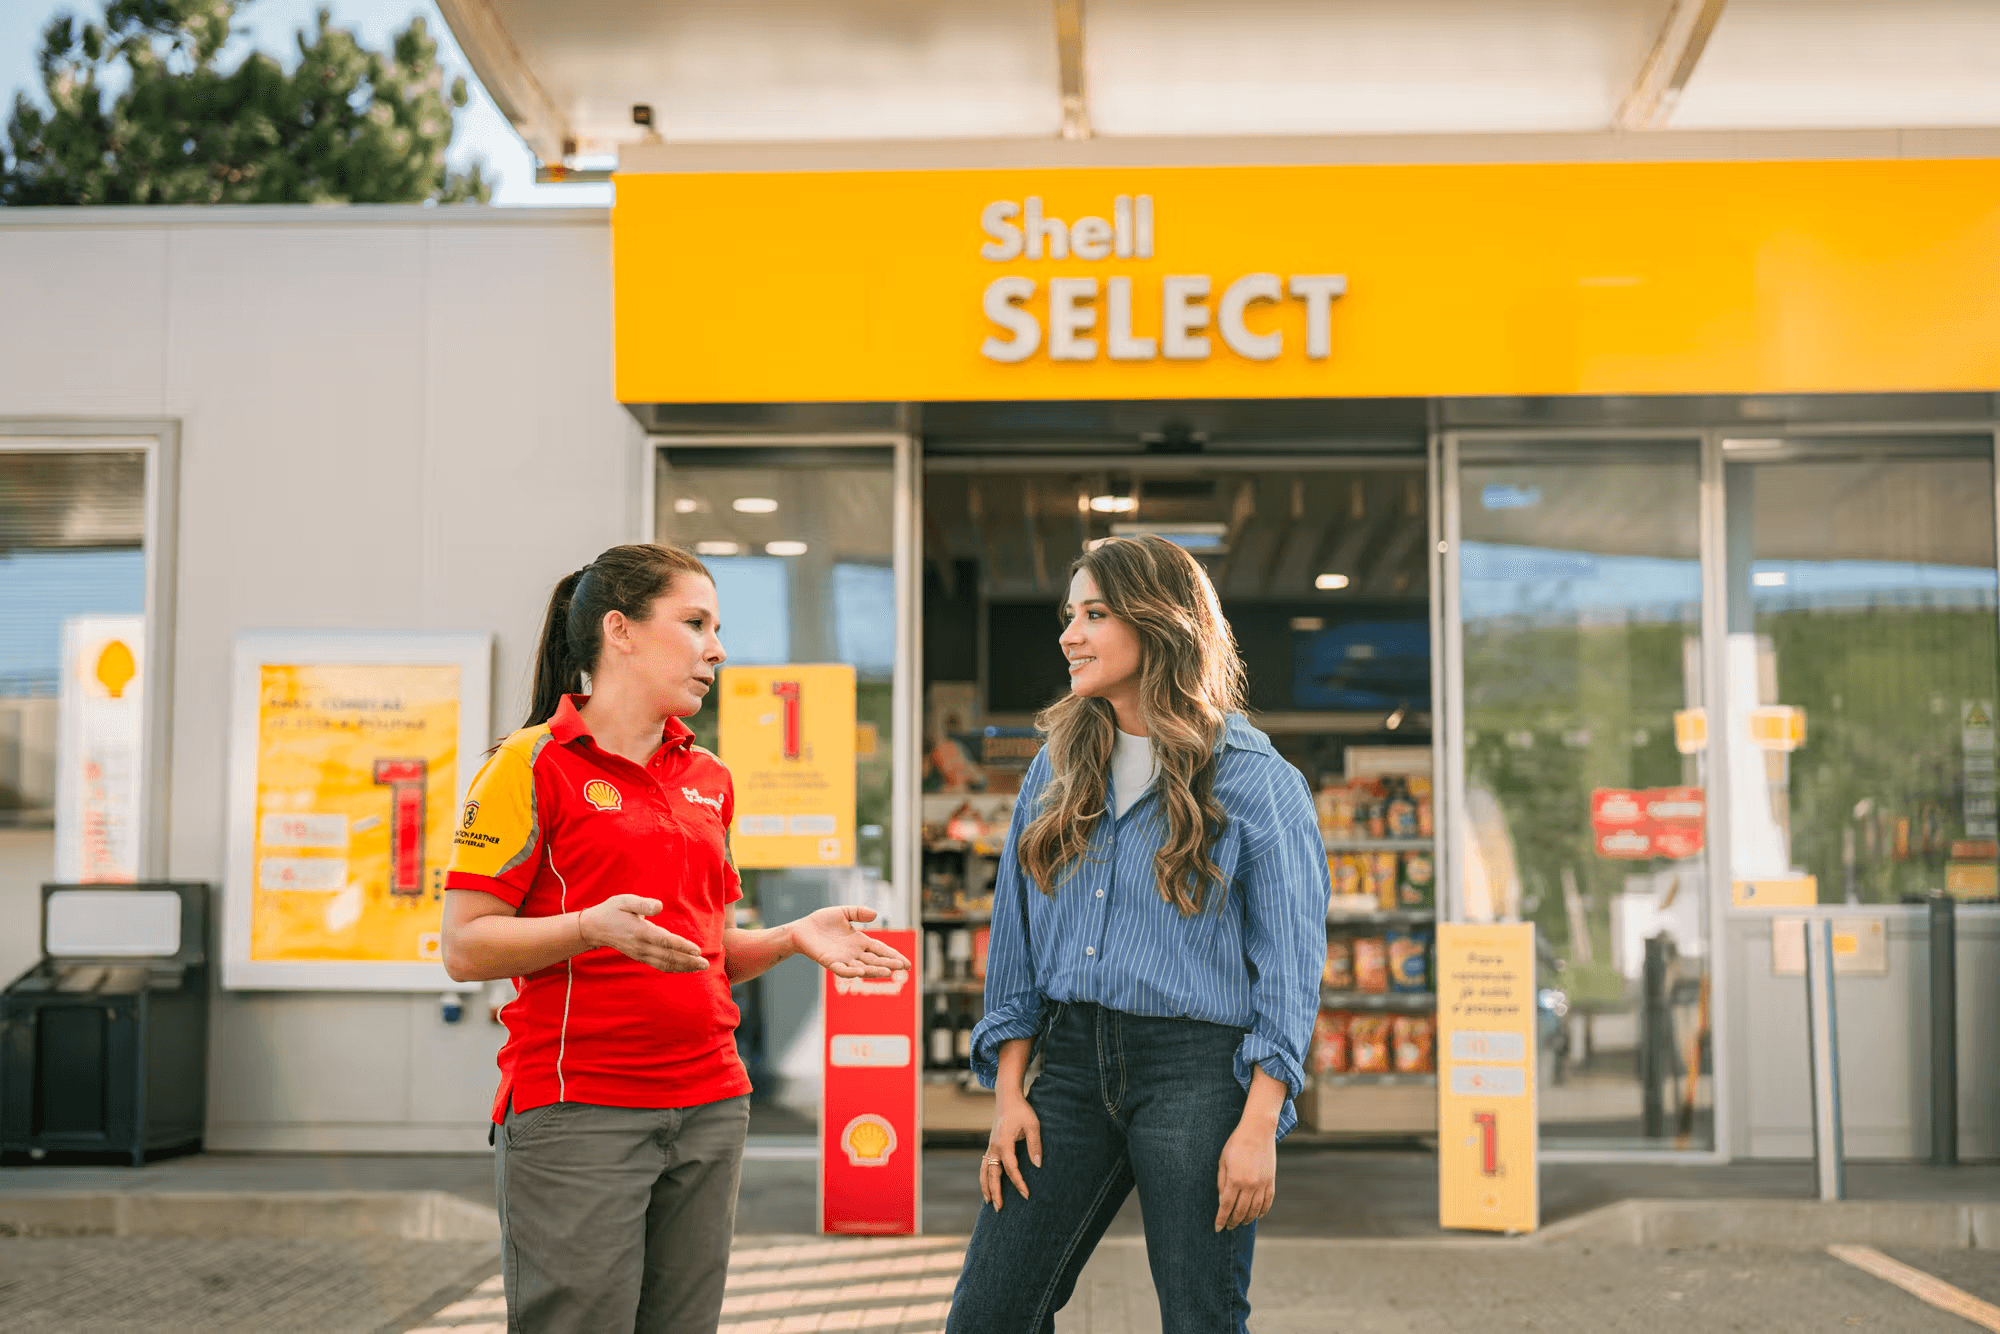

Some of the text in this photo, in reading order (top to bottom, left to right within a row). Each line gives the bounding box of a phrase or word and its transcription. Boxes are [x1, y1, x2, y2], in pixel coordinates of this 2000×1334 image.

[980, 194, 1155, 262] Shell
[980, 273, 1347, 363] SELECT
[470, 832, 500, 844] PARTNER
